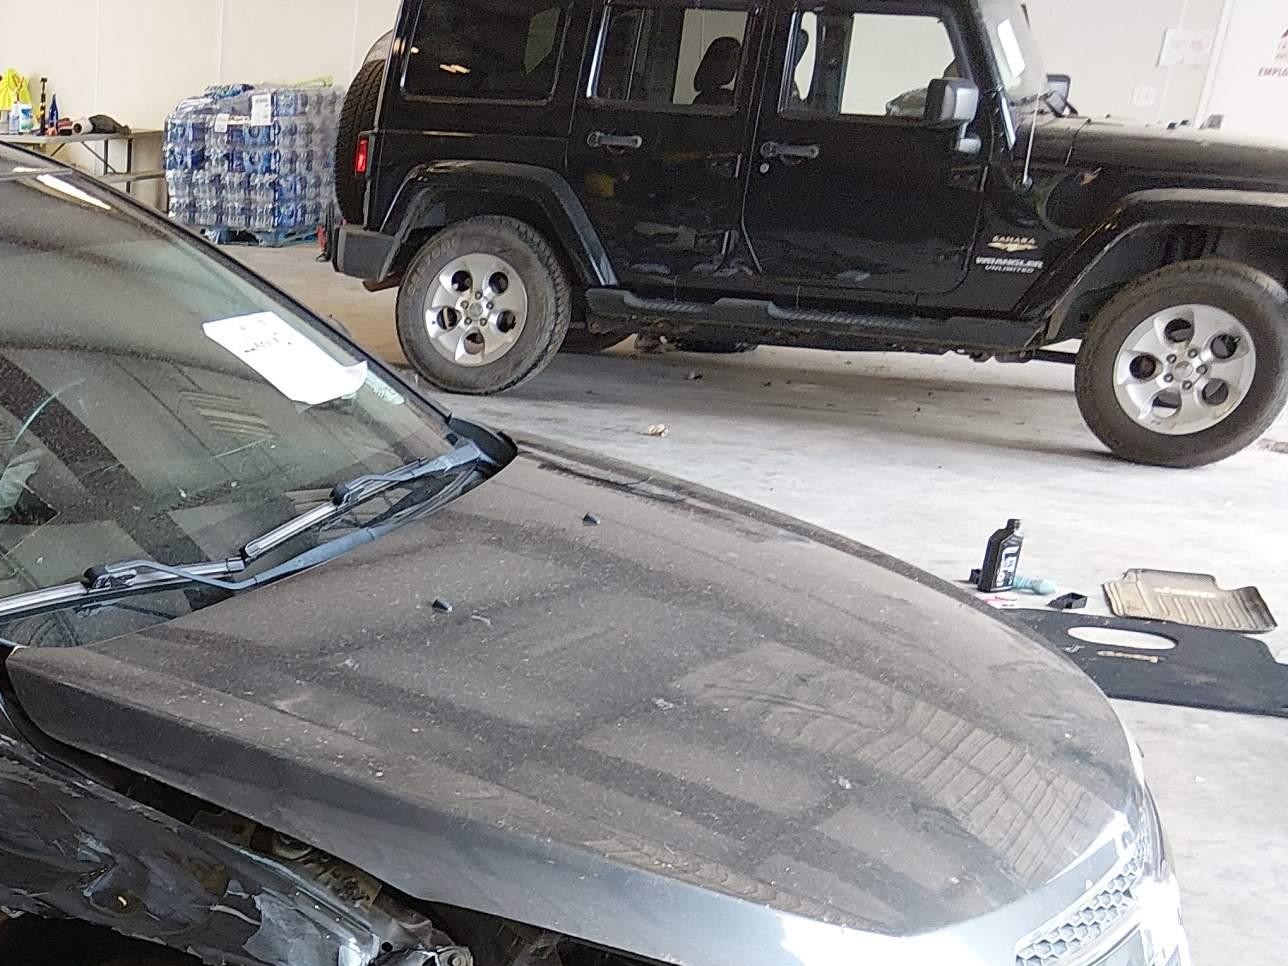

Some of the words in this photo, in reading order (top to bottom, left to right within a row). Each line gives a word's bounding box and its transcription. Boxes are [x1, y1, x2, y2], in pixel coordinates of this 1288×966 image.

[992, 235, 1036, 244] SAHARA
[975, 257, 1044, 269] WRANGLER
[984, 264, 1035, 274] UNLIMITED
